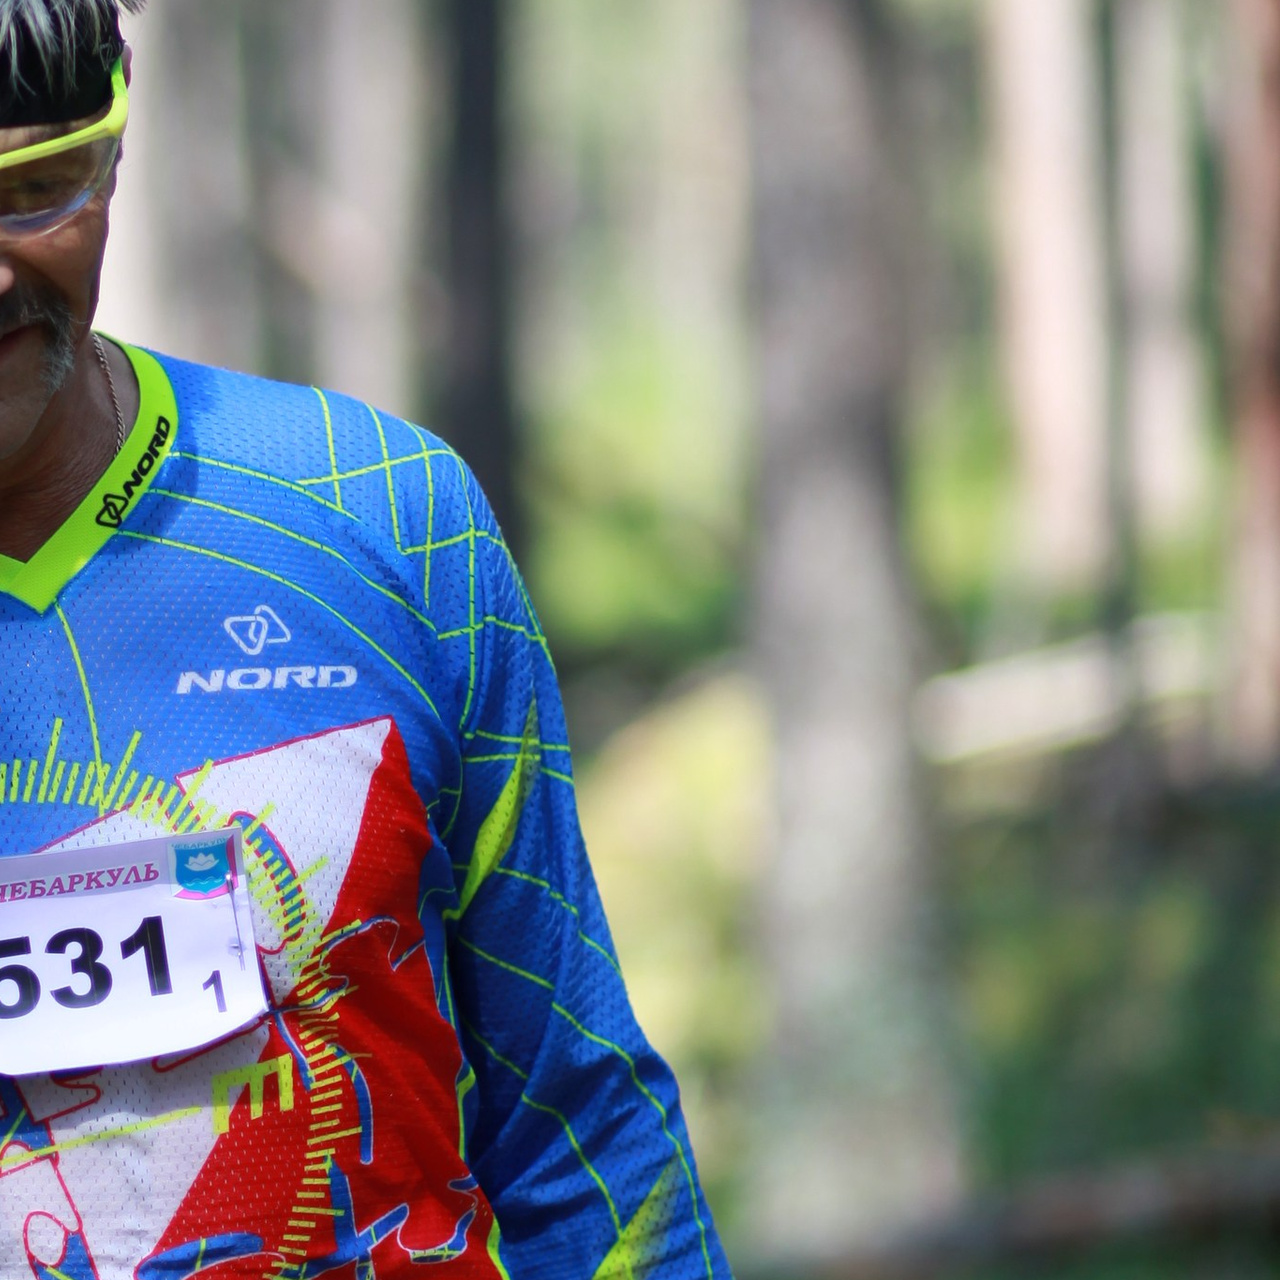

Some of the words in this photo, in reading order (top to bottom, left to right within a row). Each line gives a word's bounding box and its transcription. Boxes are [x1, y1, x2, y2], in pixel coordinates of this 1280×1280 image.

[124, 415, 170, 498] NORD
[176, 665, 358, 695] NORD
[202, 970, 228, 1013] 1
